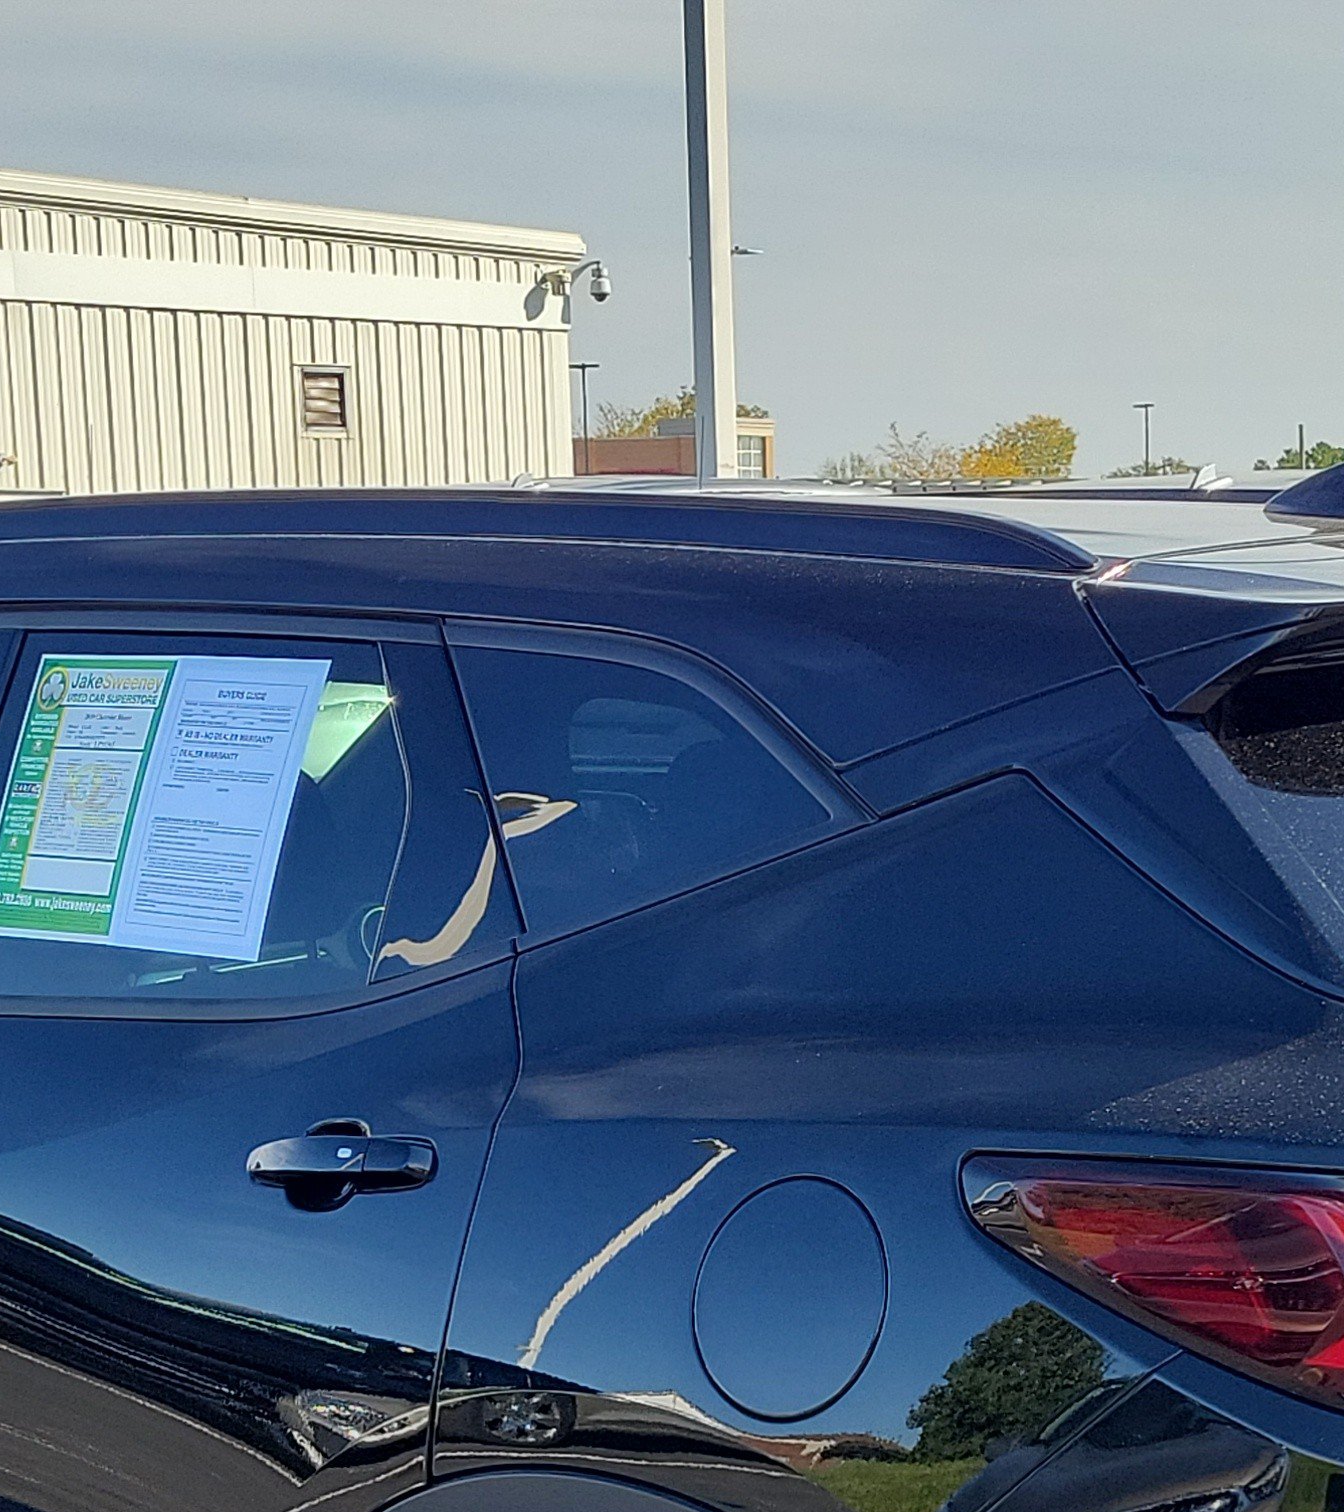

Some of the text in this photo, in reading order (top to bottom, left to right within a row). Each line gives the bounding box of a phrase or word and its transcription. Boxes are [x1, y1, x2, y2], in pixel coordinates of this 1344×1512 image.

[66, 692, 159, 705] USED CAR SUPERSTORE
